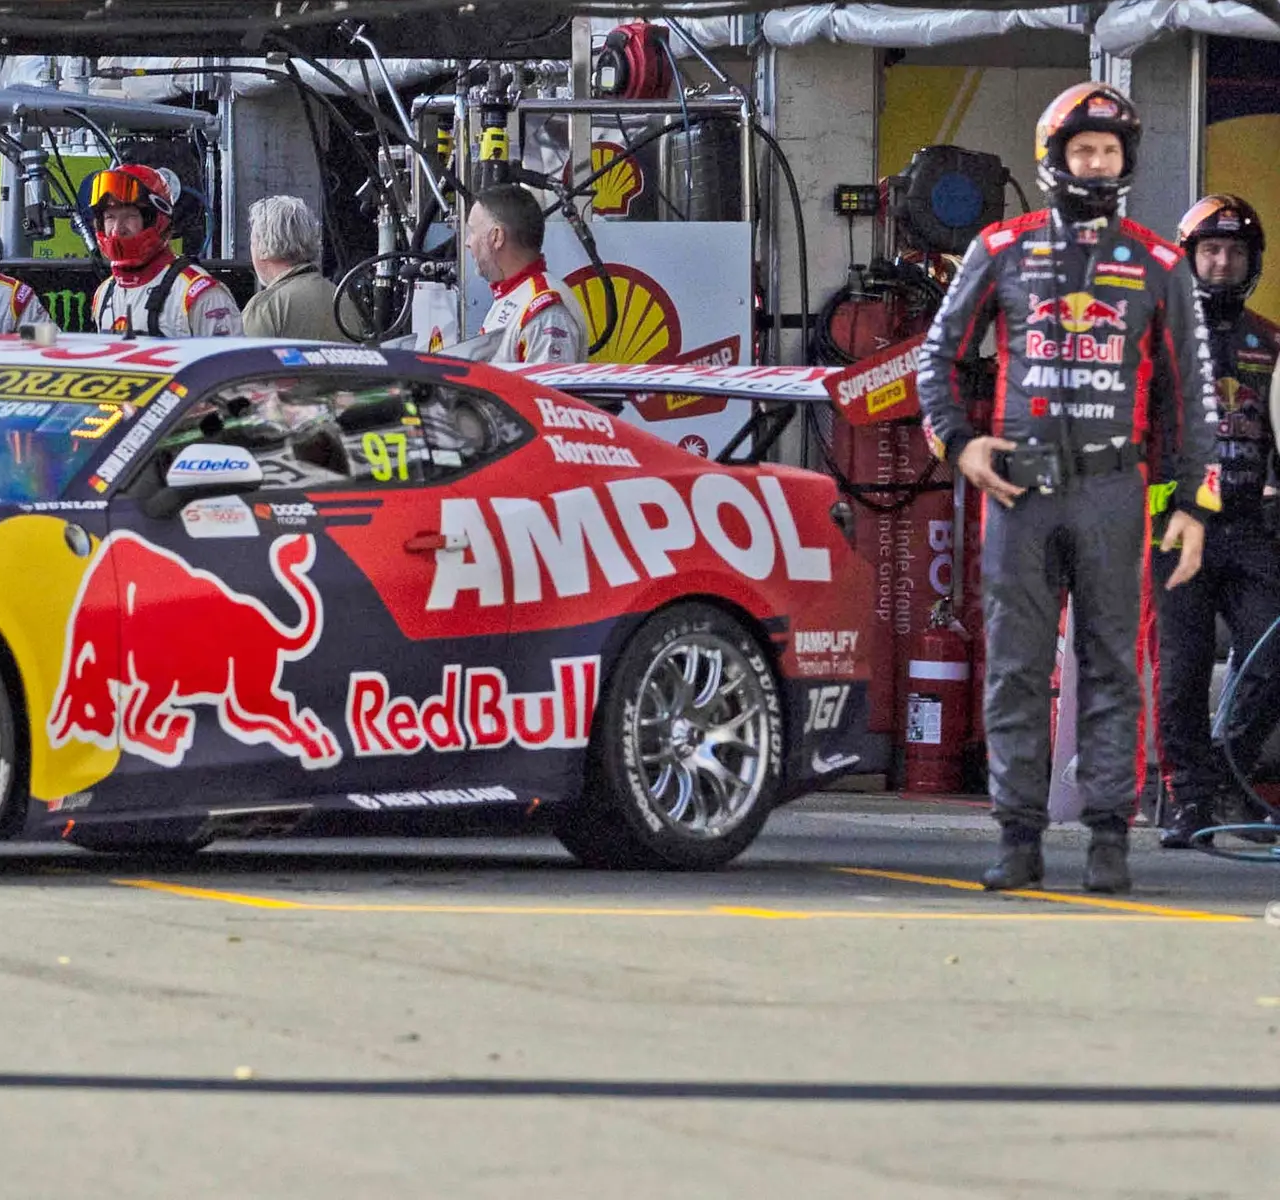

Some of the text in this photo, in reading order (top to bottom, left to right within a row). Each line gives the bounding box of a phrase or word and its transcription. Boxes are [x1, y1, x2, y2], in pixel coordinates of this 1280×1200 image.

[539, 398, 617, 440] Harvey
[175, 457, 250, 472] ACDelco
[362, 432, 410, 482] 97
[545, 435, 641, 468] Norman
[425, 472, 832, 611] AMPOL
